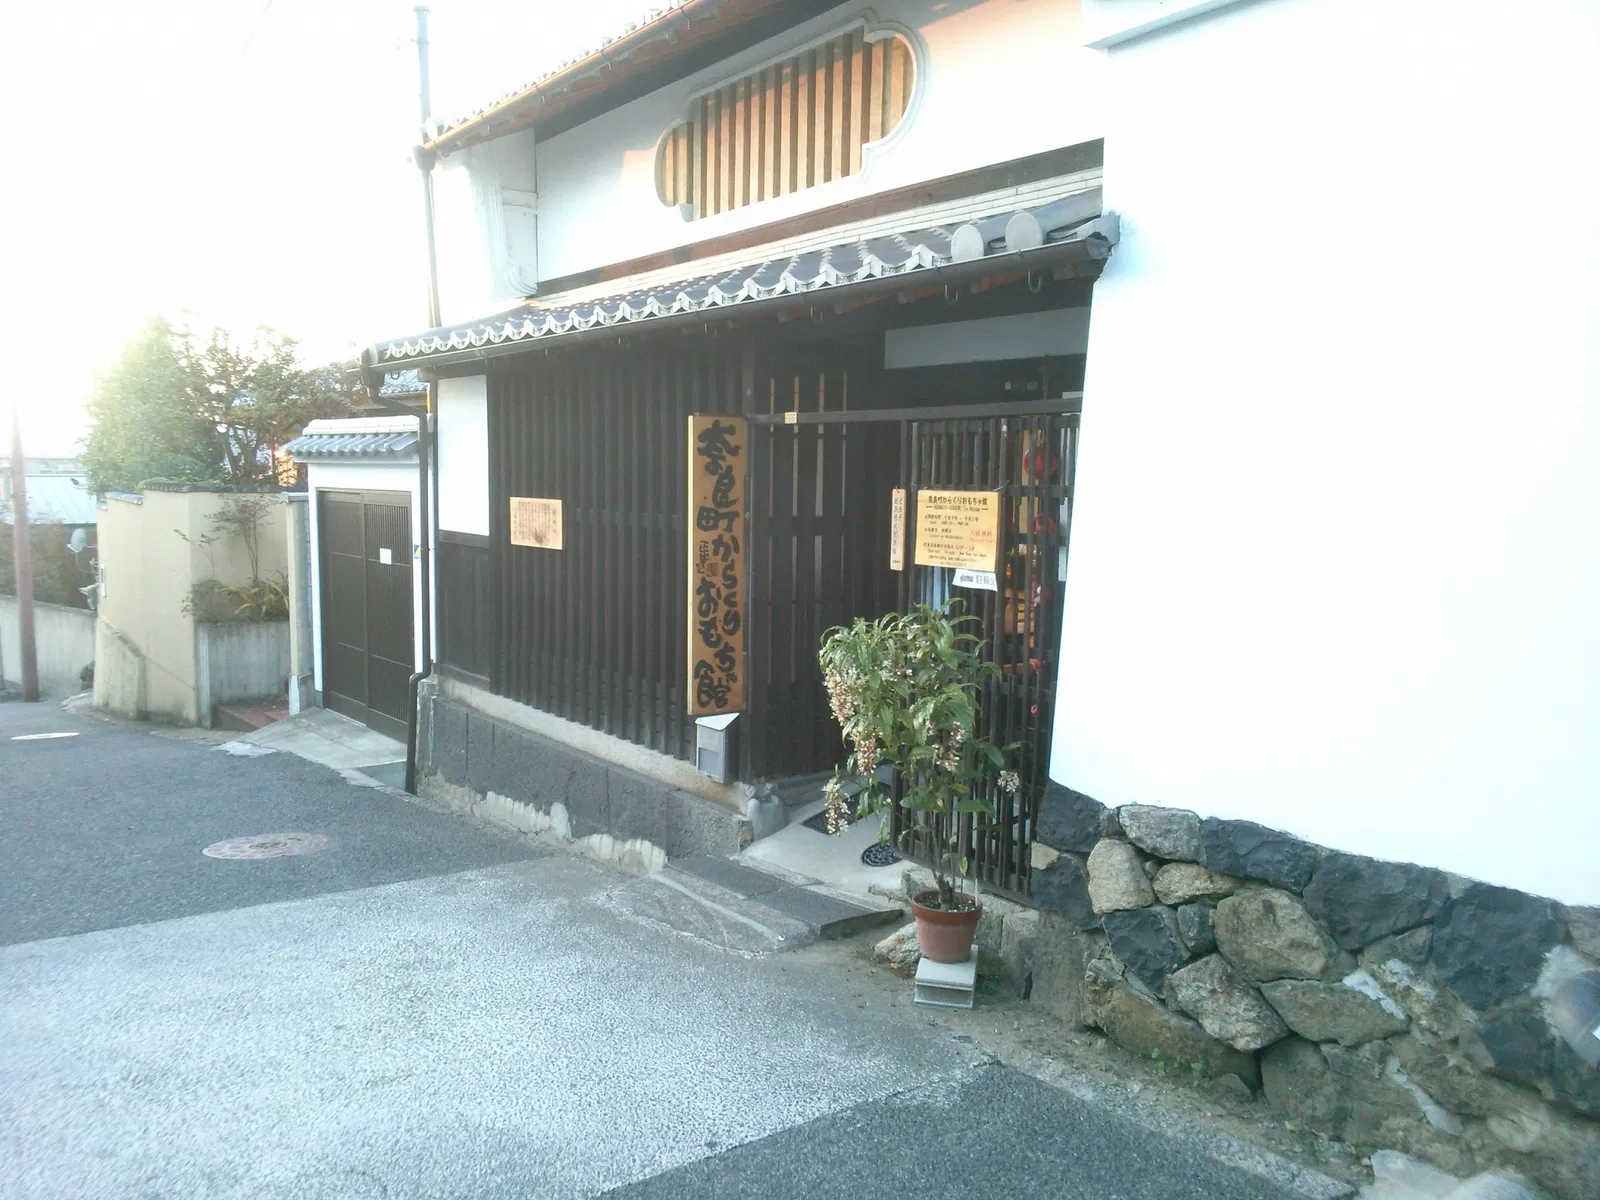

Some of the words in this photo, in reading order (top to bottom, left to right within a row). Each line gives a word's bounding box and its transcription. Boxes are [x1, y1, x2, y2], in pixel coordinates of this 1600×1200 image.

[695, 419, 741, 709] 奈良町からくりおもちゃ館
